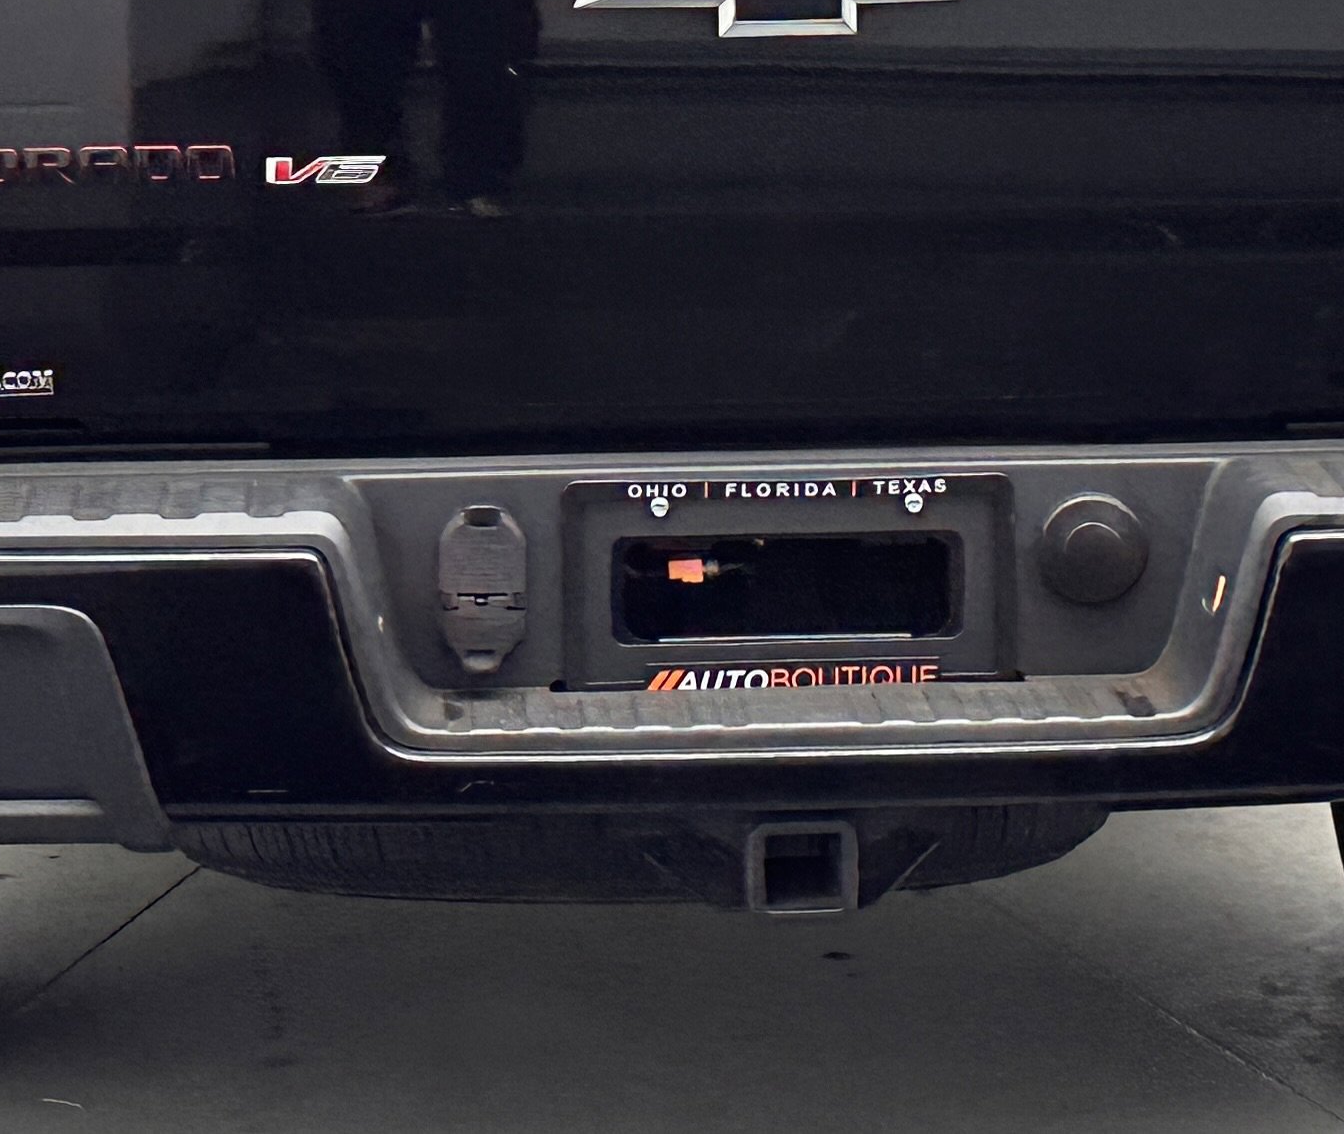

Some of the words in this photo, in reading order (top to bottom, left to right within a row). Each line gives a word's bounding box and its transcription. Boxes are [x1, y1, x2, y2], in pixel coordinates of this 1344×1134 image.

[266, 155, 386, 184] V6
[627, 483, 687, 498] OHIO
[725, 482, 837, 497] FLORIDA
[873, 478, 948, 495] TEXAS
